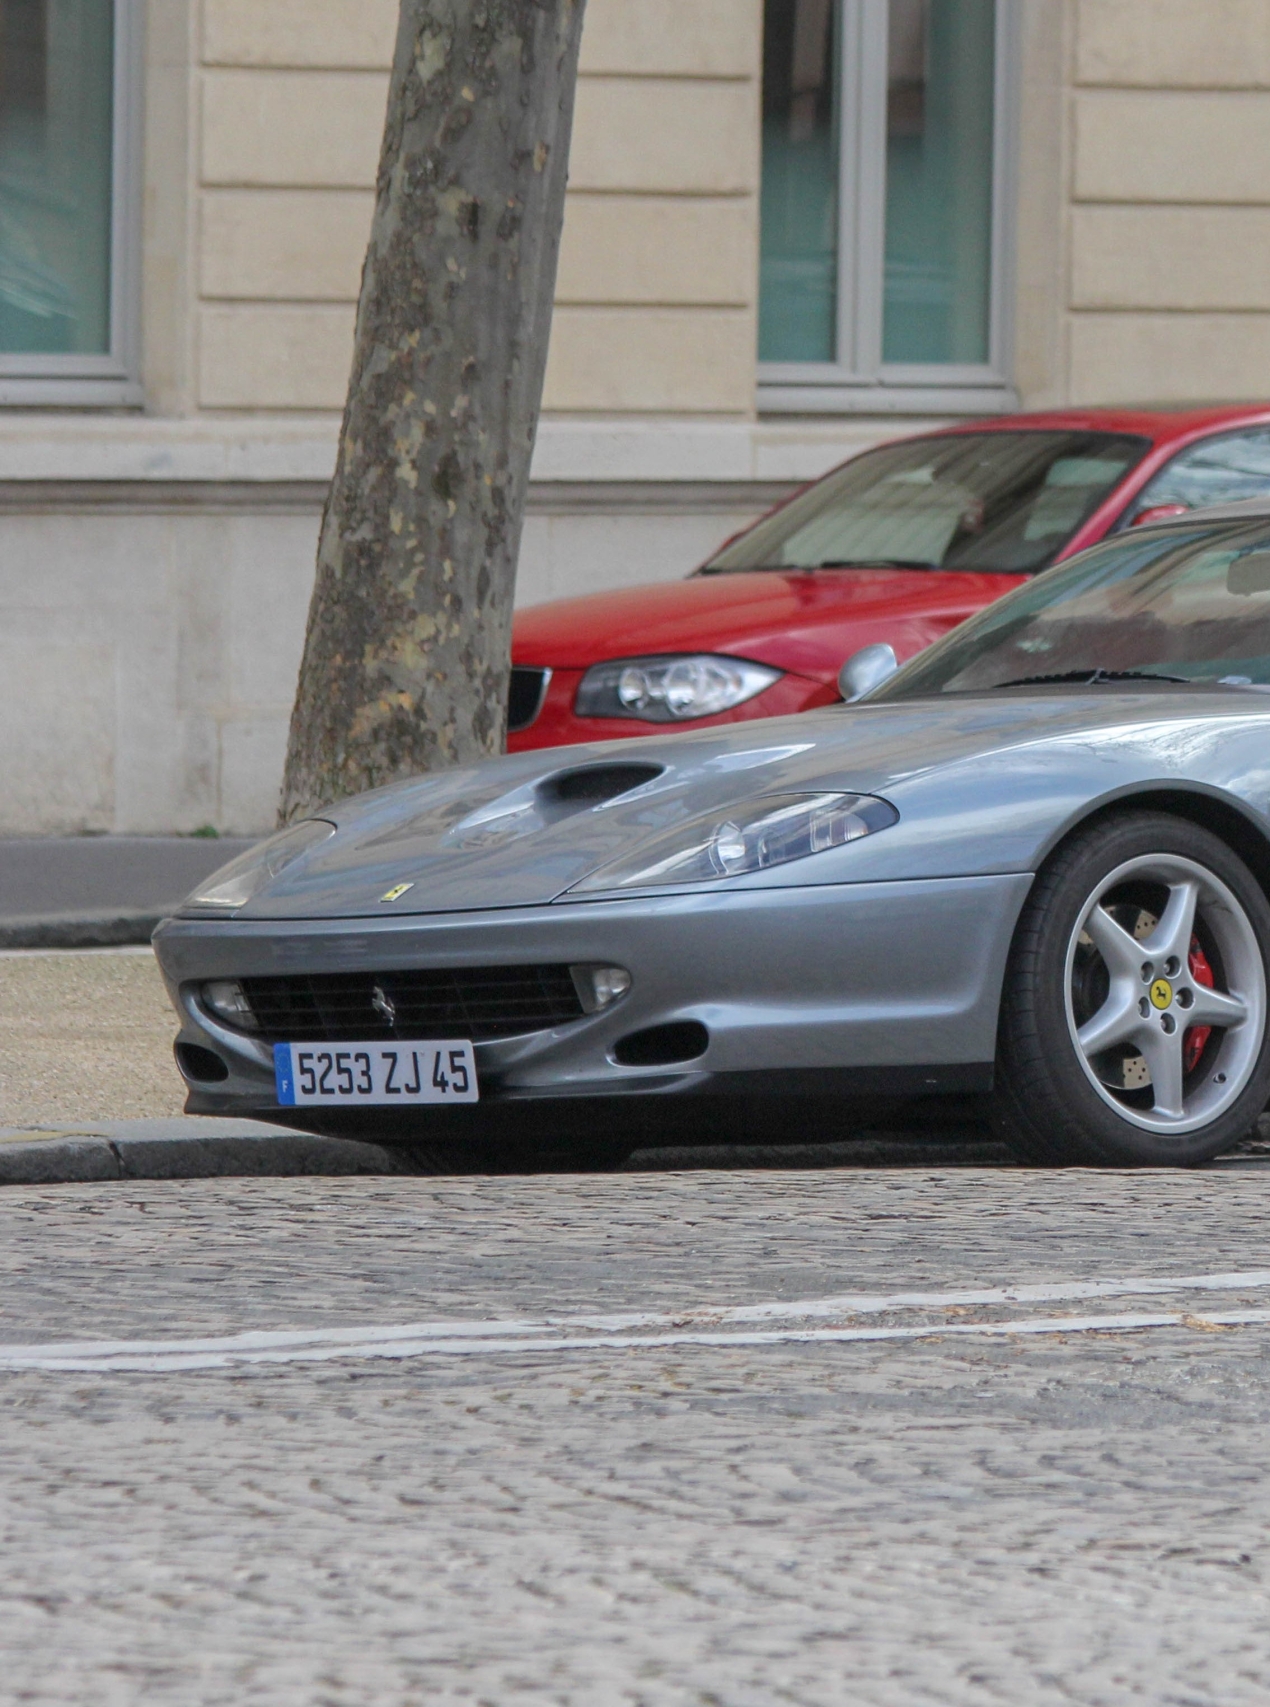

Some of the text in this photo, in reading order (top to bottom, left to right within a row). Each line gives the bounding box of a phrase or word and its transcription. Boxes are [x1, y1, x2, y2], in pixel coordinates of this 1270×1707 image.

[282, 1079, 288, 1093] F
[298, 1050, 469, 1095] 5253 ZJ 45
